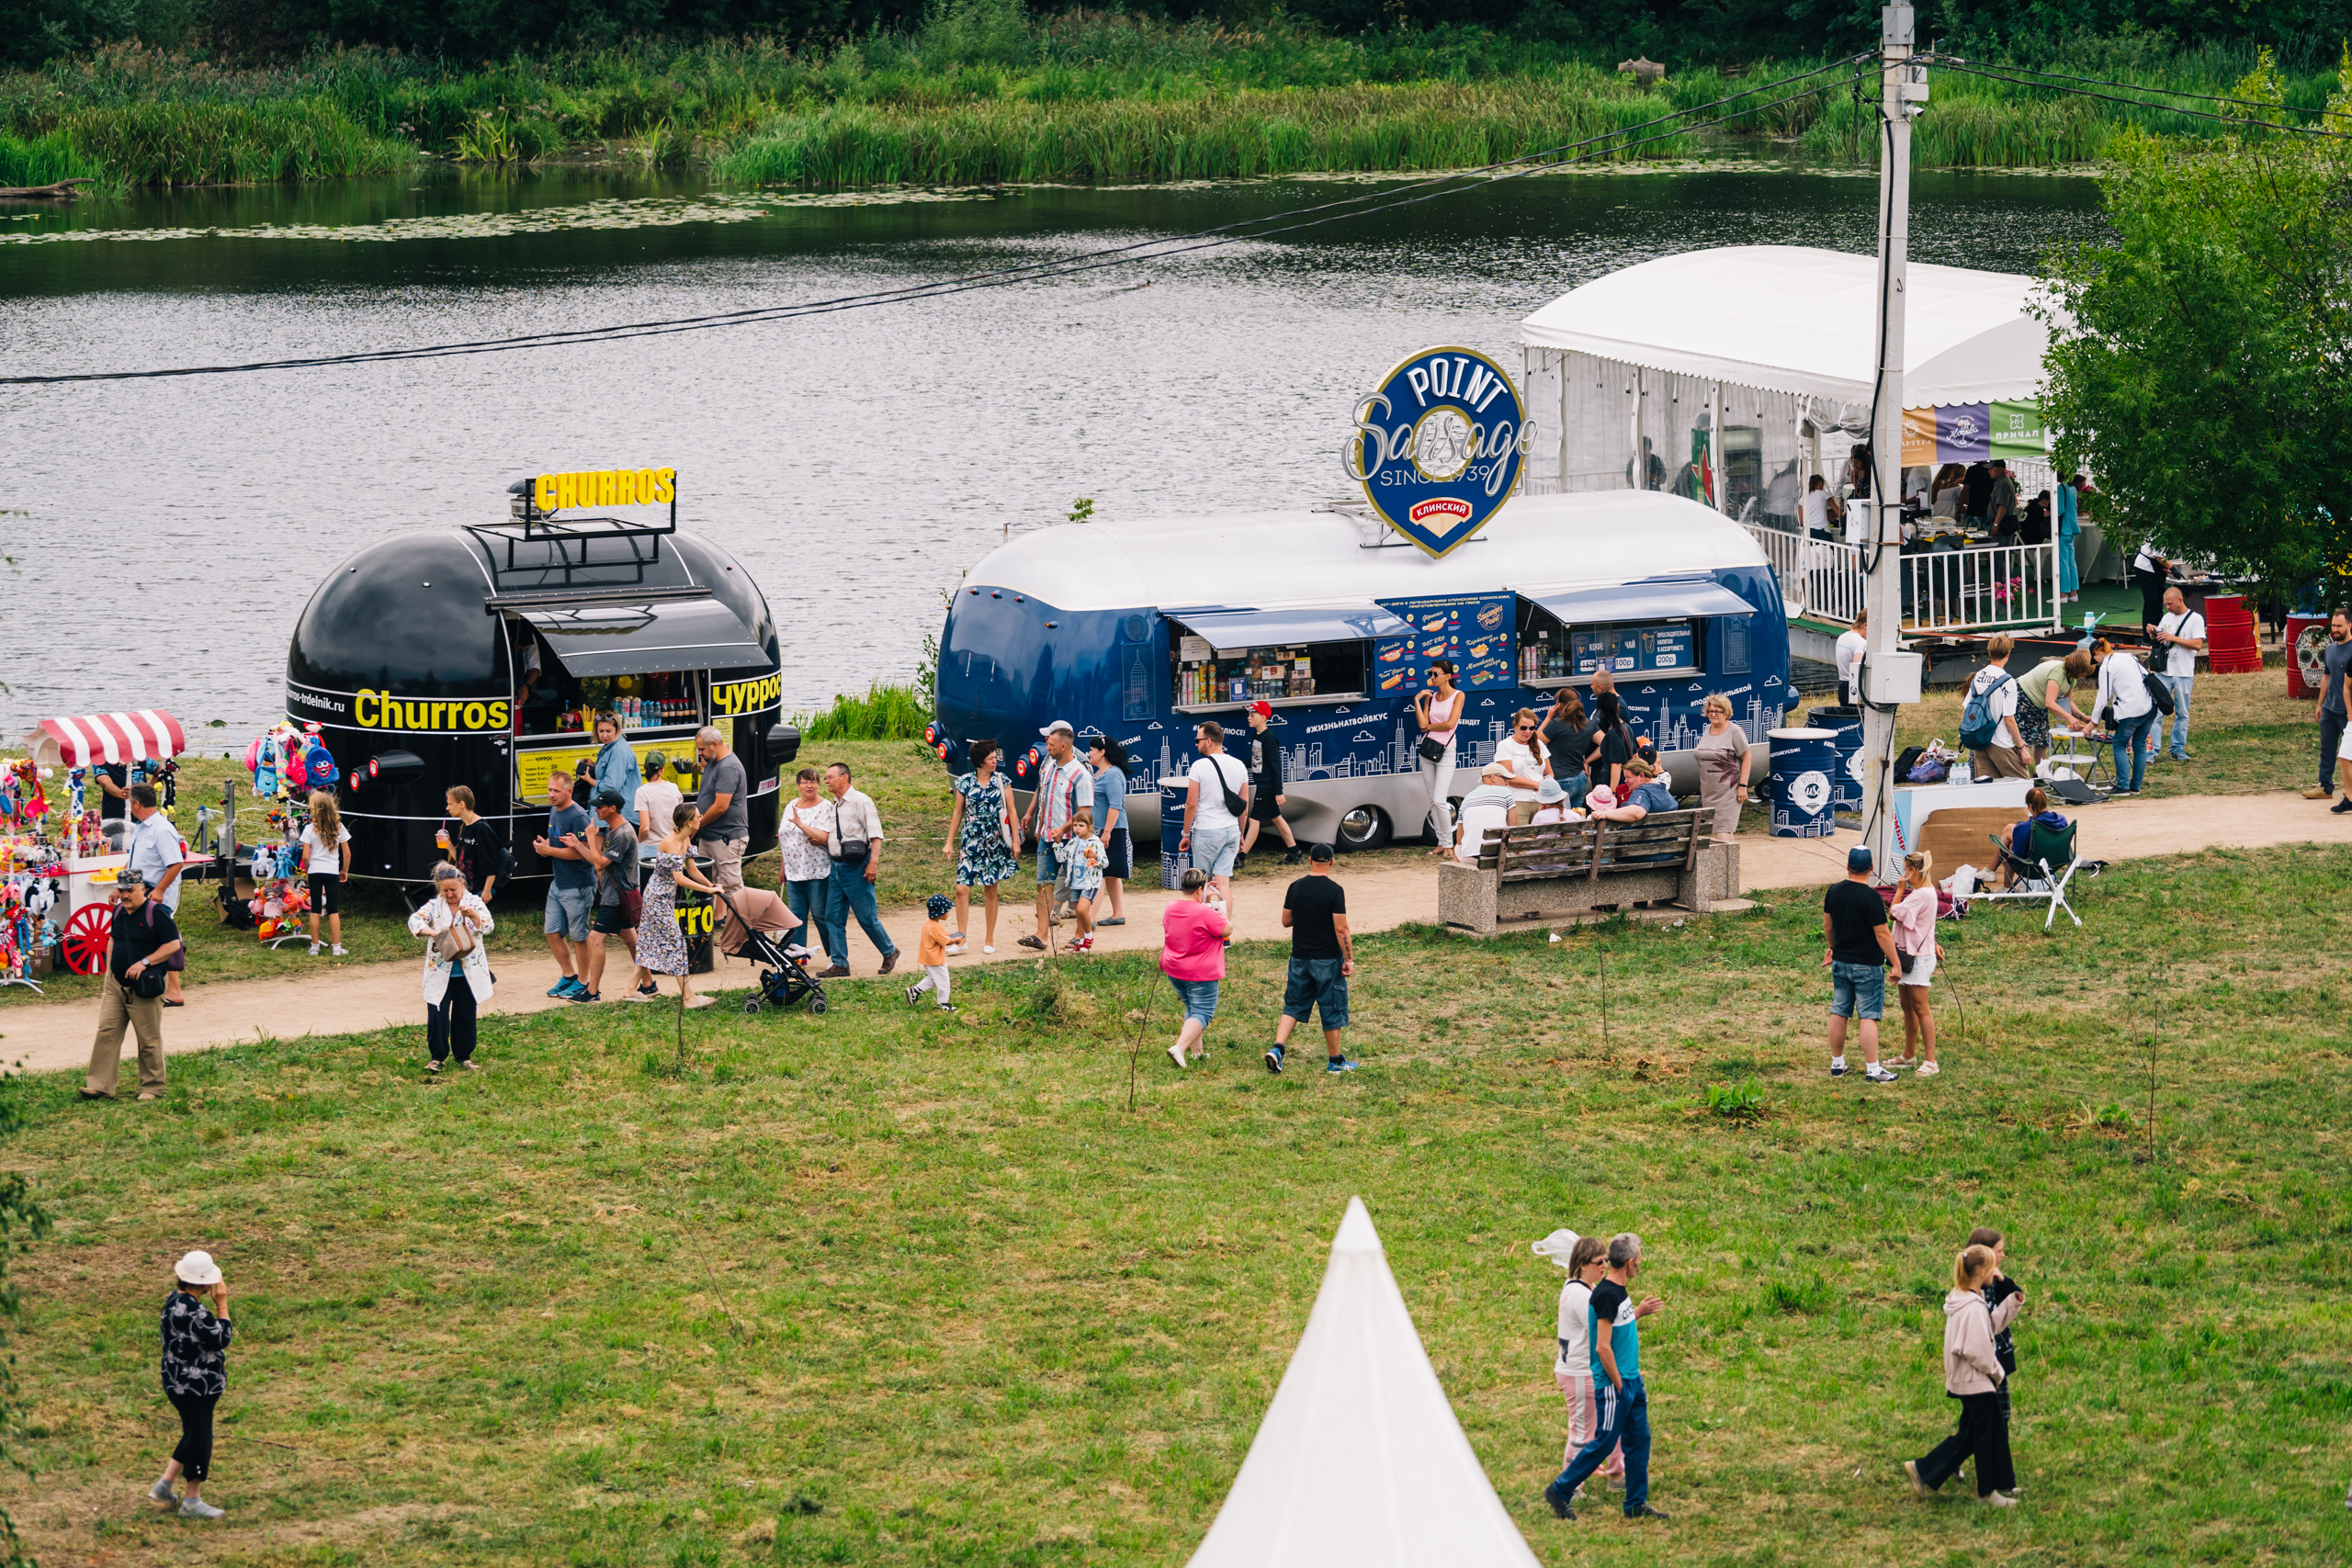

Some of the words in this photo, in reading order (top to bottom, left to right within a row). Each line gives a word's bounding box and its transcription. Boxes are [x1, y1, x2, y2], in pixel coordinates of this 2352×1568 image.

[1407, 356, 1508, 413] POINT
[1996, 430, 2039, 440] ПРИЧАЛ
[1380, 468, 1447, 487] SINCE
[1448, 465, 1490, 483] 1939
[535, 466, 675, 512] CHURROS
[1416, 502, 1467, 517] КЛИНСКИЙ
[1476, 604, 1503, 623] Sausages
[1589, 642, 1604, 651] КОФЕ
[1624, 639, 1636, 649] ЧАЙ
[355, 688, 509, 729] Churros
[1306, 712, 1388, 734] #ЖИЗНЬНАТВОЙВКУС
